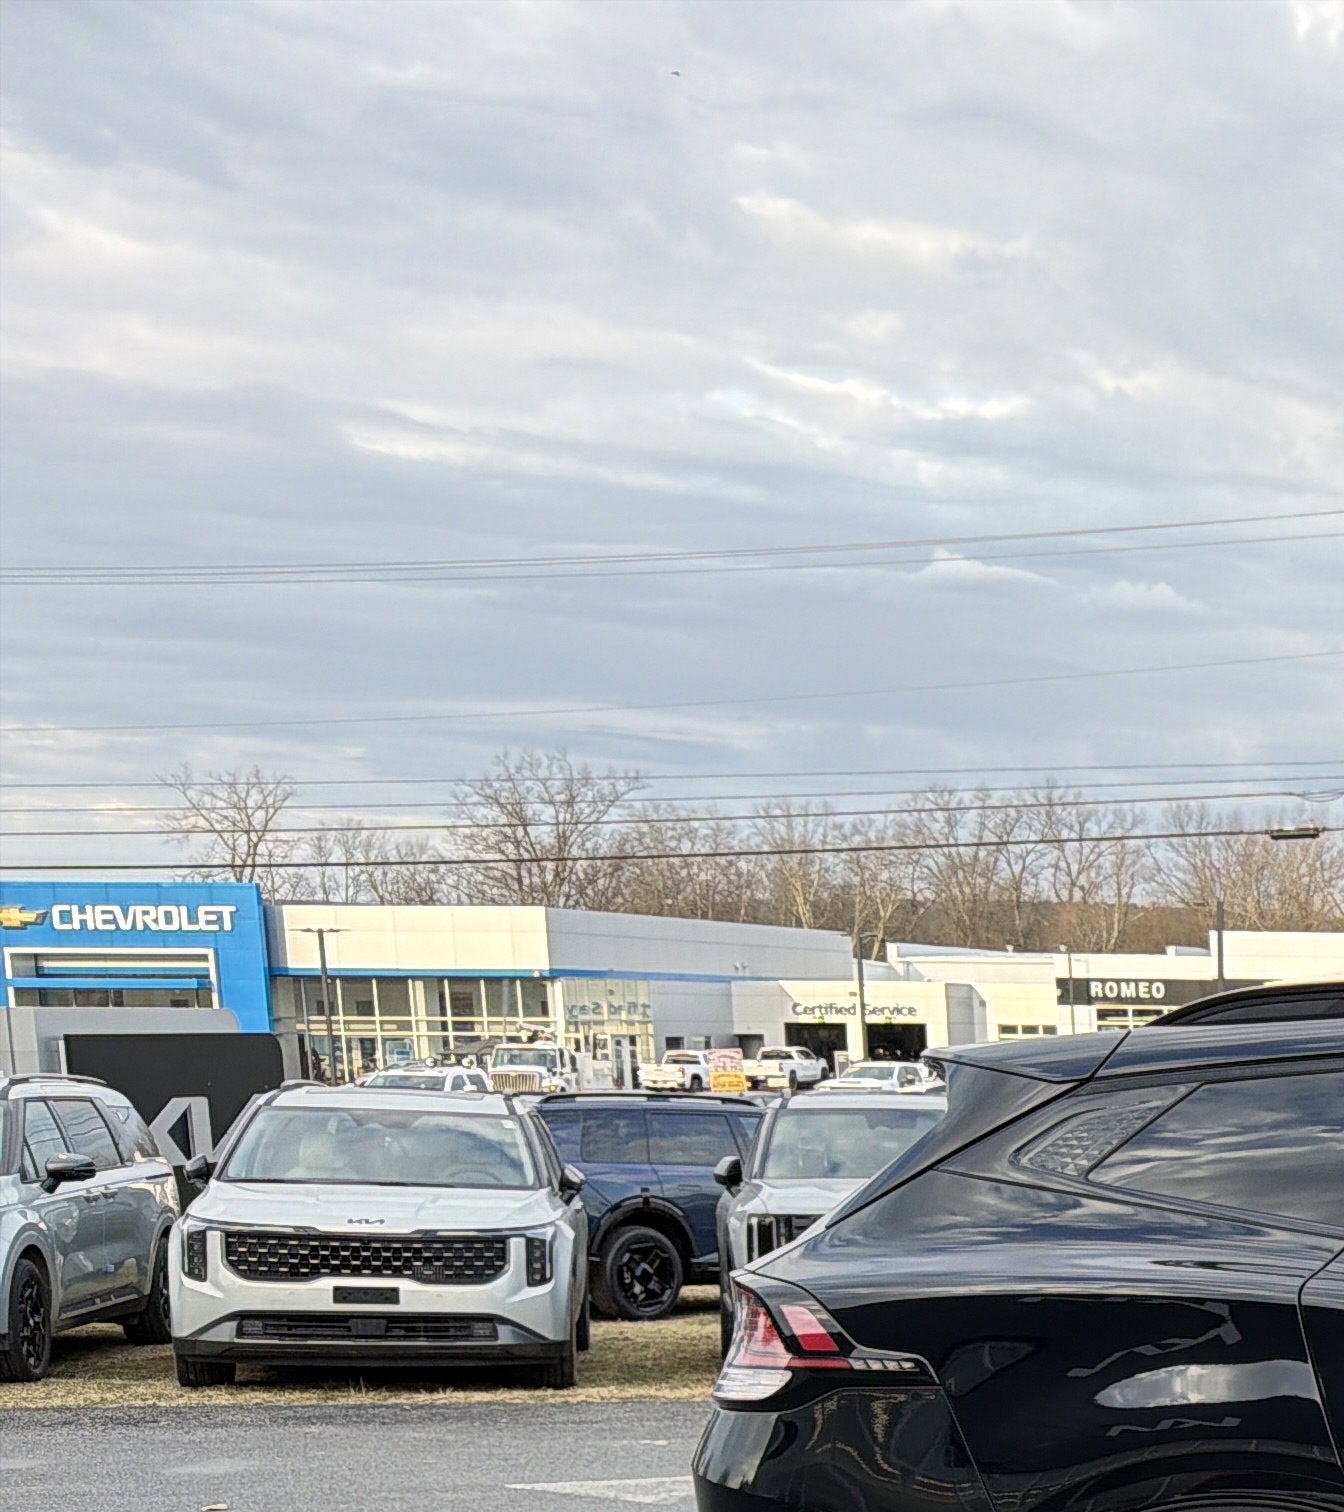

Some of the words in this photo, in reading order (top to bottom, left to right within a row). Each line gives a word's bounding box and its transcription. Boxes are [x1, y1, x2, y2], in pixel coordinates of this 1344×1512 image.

[51, 904, 237, 931] CHEVROLET
[1089, 981, 1166, 999] ROMEO
[792, 1002, 857, 1017] Certified
[863, 1002, 917, 1018] Service
